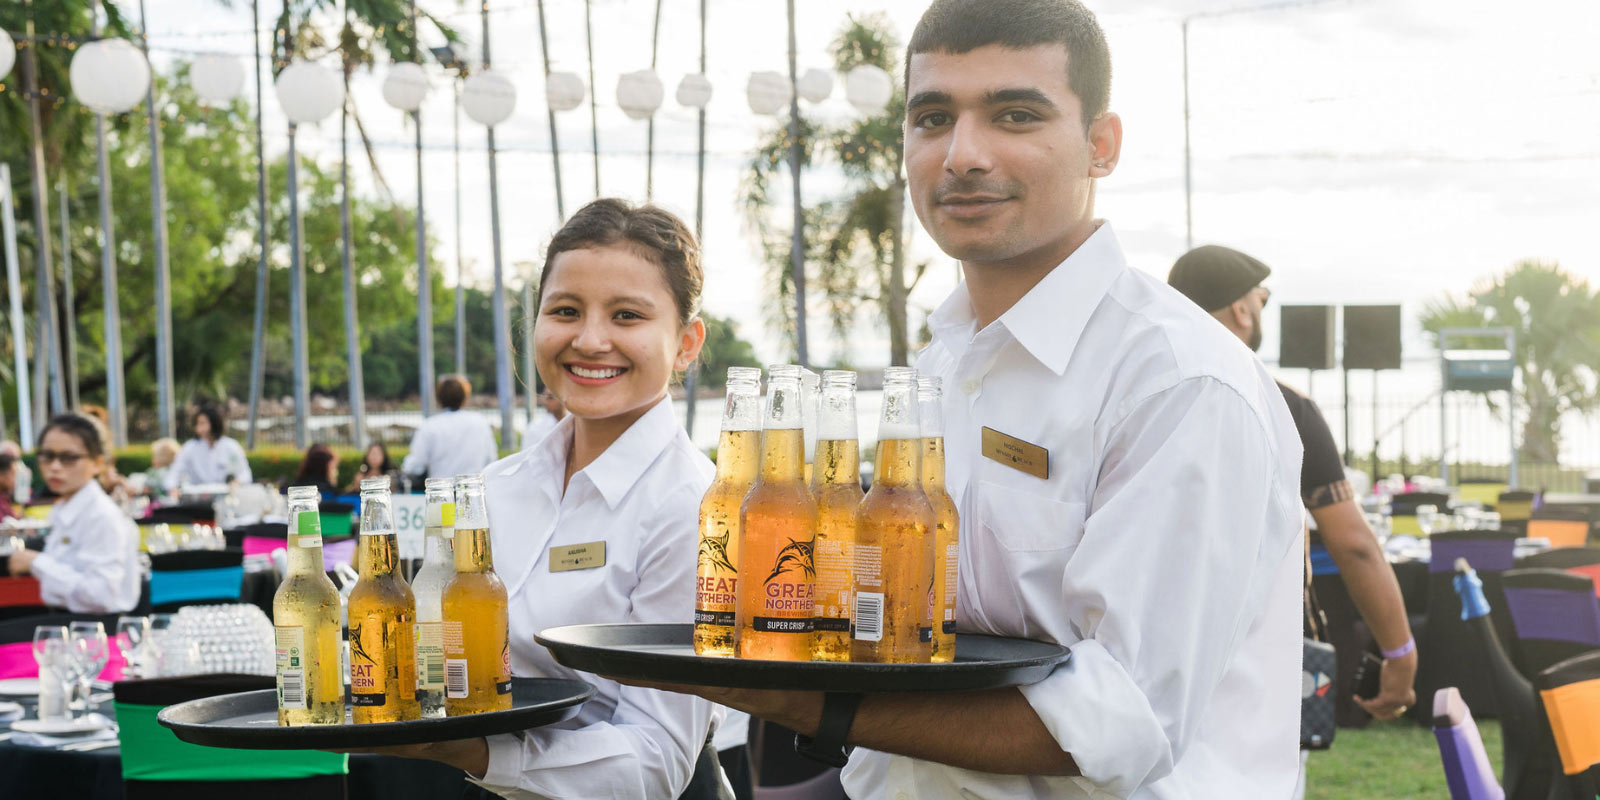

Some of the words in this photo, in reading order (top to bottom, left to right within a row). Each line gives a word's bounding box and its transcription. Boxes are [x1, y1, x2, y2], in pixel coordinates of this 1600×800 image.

[398, 506, 424, 530] 36
[766, 583, 816, 598] GREA
[765, 599, 815, 610] NORTHER
[767, 621, 788, 630] SUPER
[789, 622, 805, 631] CRISP
[351, 664, 373, 677] EAT
